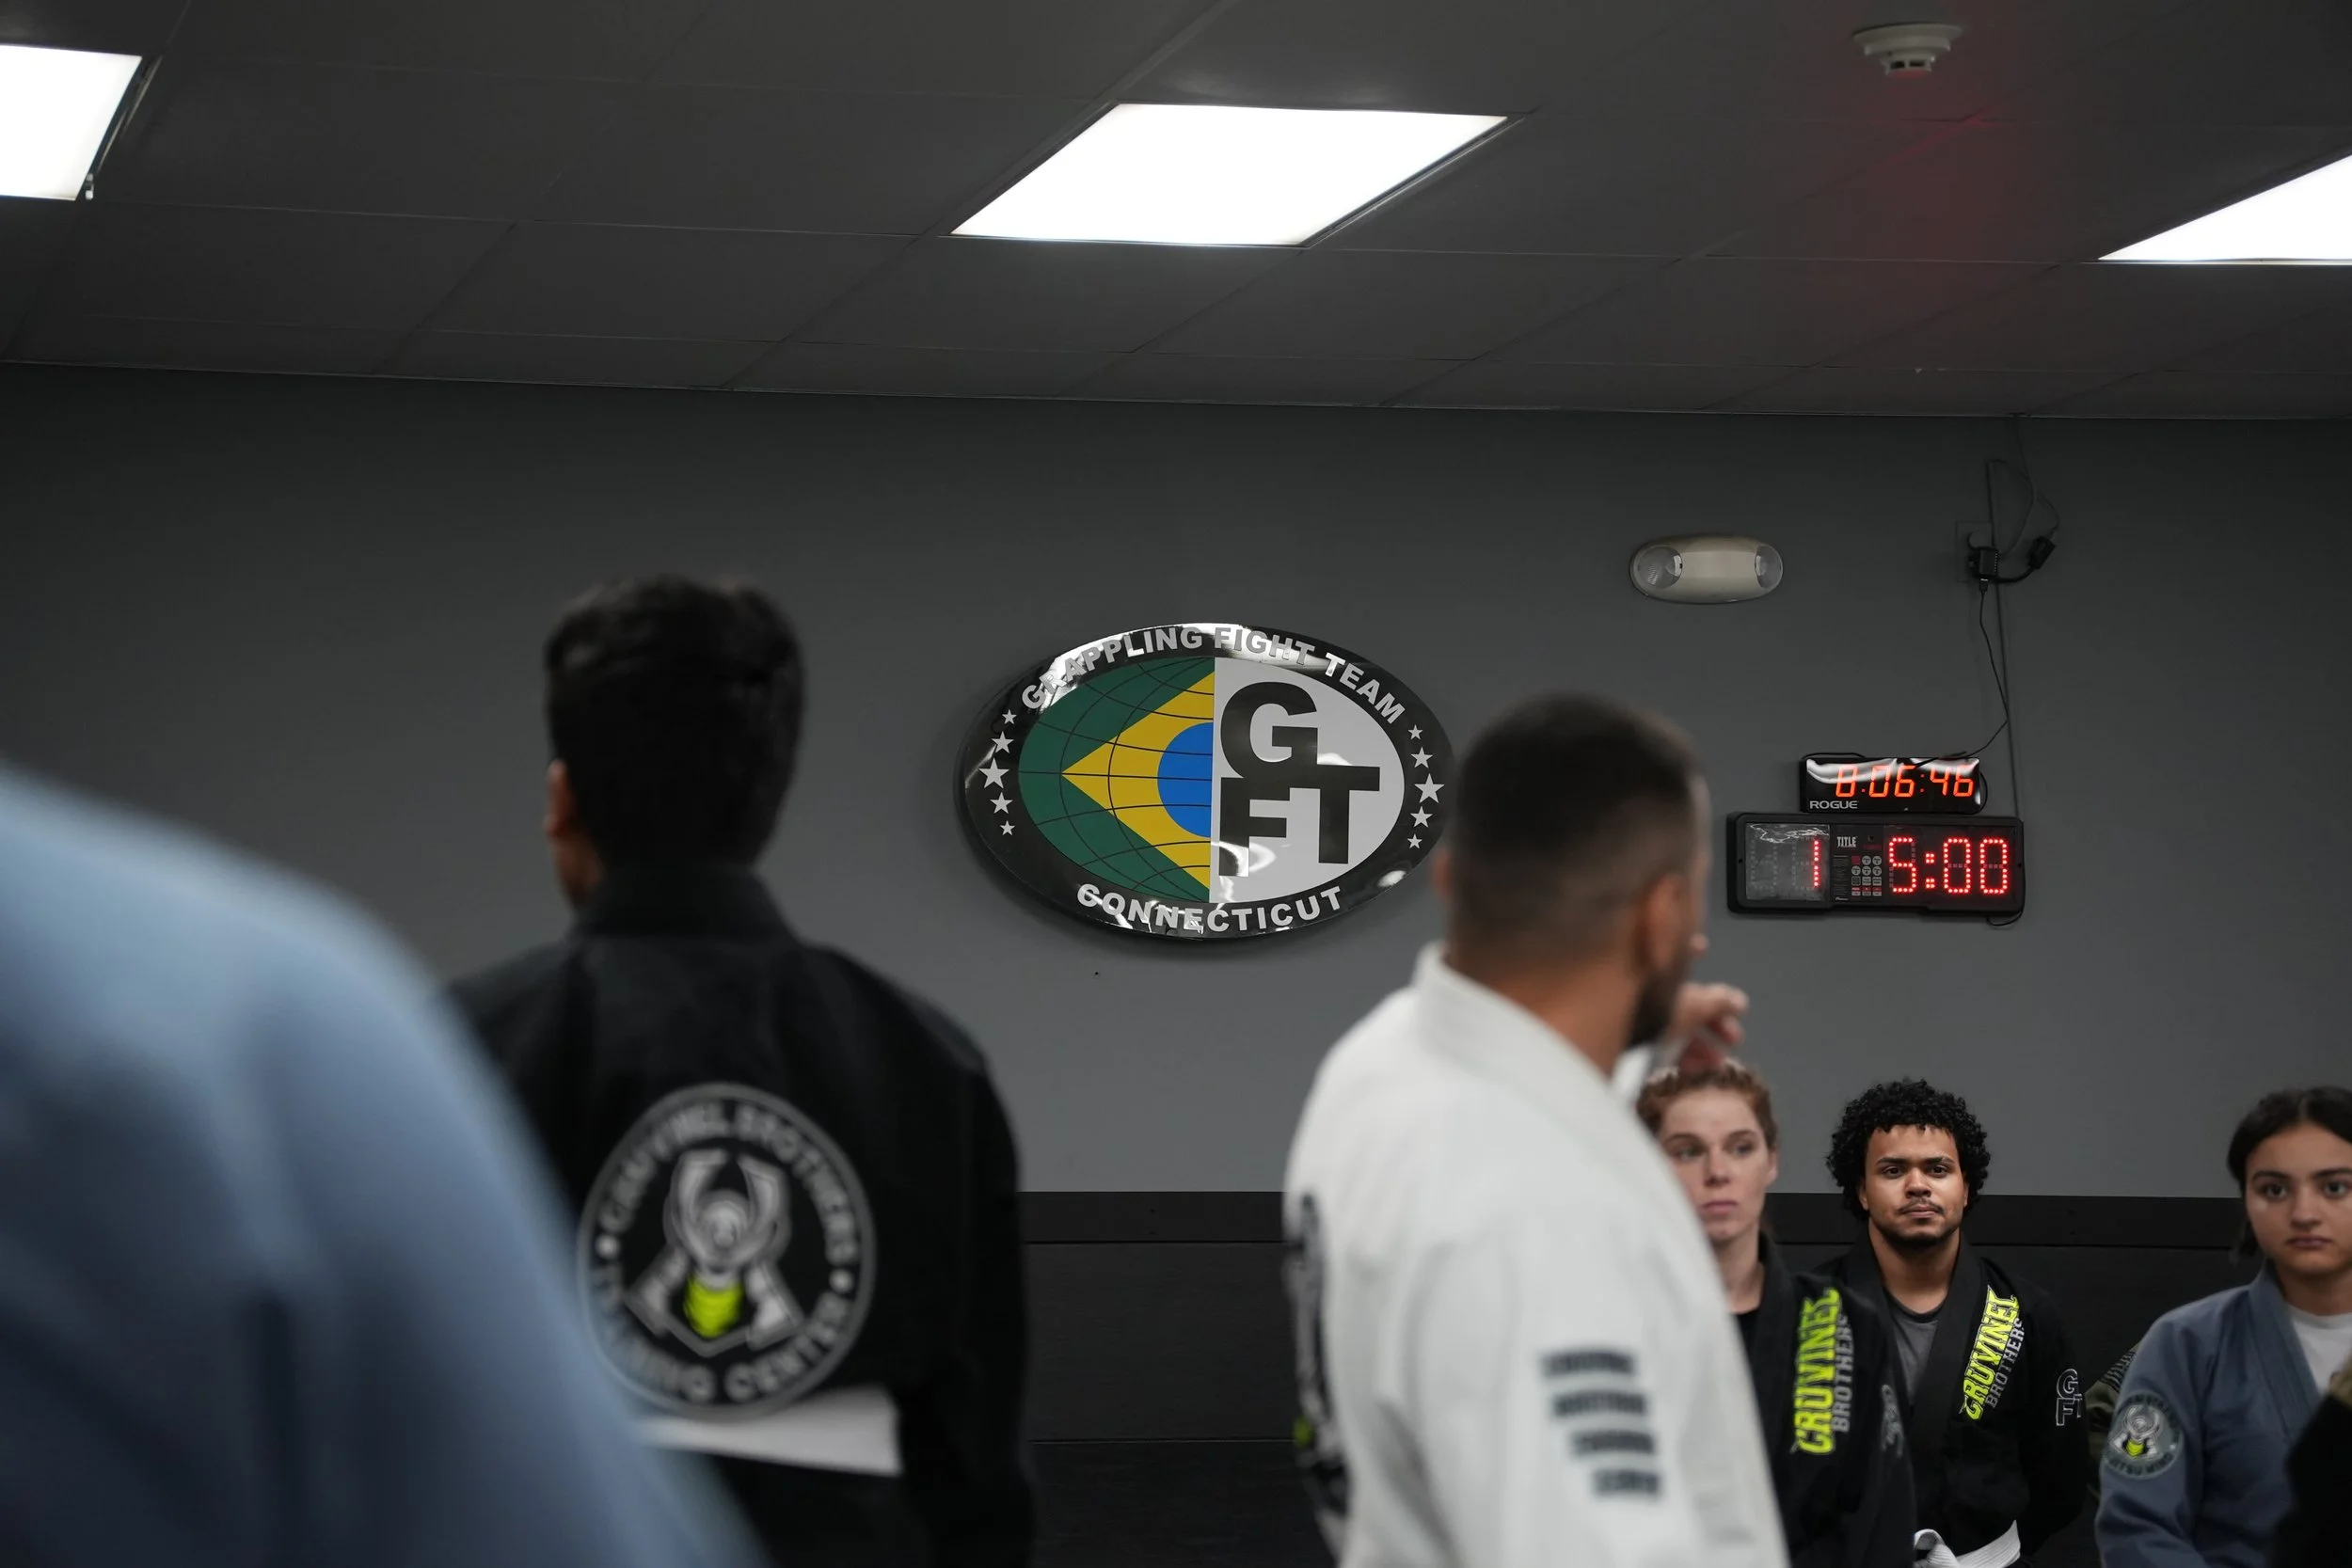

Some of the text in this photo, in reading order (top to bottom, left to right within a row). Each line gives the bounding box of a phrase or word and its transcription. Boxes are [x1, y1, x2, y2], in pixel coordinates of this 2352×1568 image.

[1021, 626, 1406, 725] GRAPPLING FIGHT TEAM
[1809, 800, 1858, 810] ROGUE
[1812, 839, 1820, 888] 1
[1836, 836, 1857, 848] TITLE
[1888, 837, 2009, 895] 5:00
[1076, 883, 1342, 934] CONNECTICUT
[1833, 1314, 1854, 1433] BROTHERS
[1959, 1284, 2020, 1420] CRUVINEL
[1984, 1317, 2026, 1409] BROTHERS
